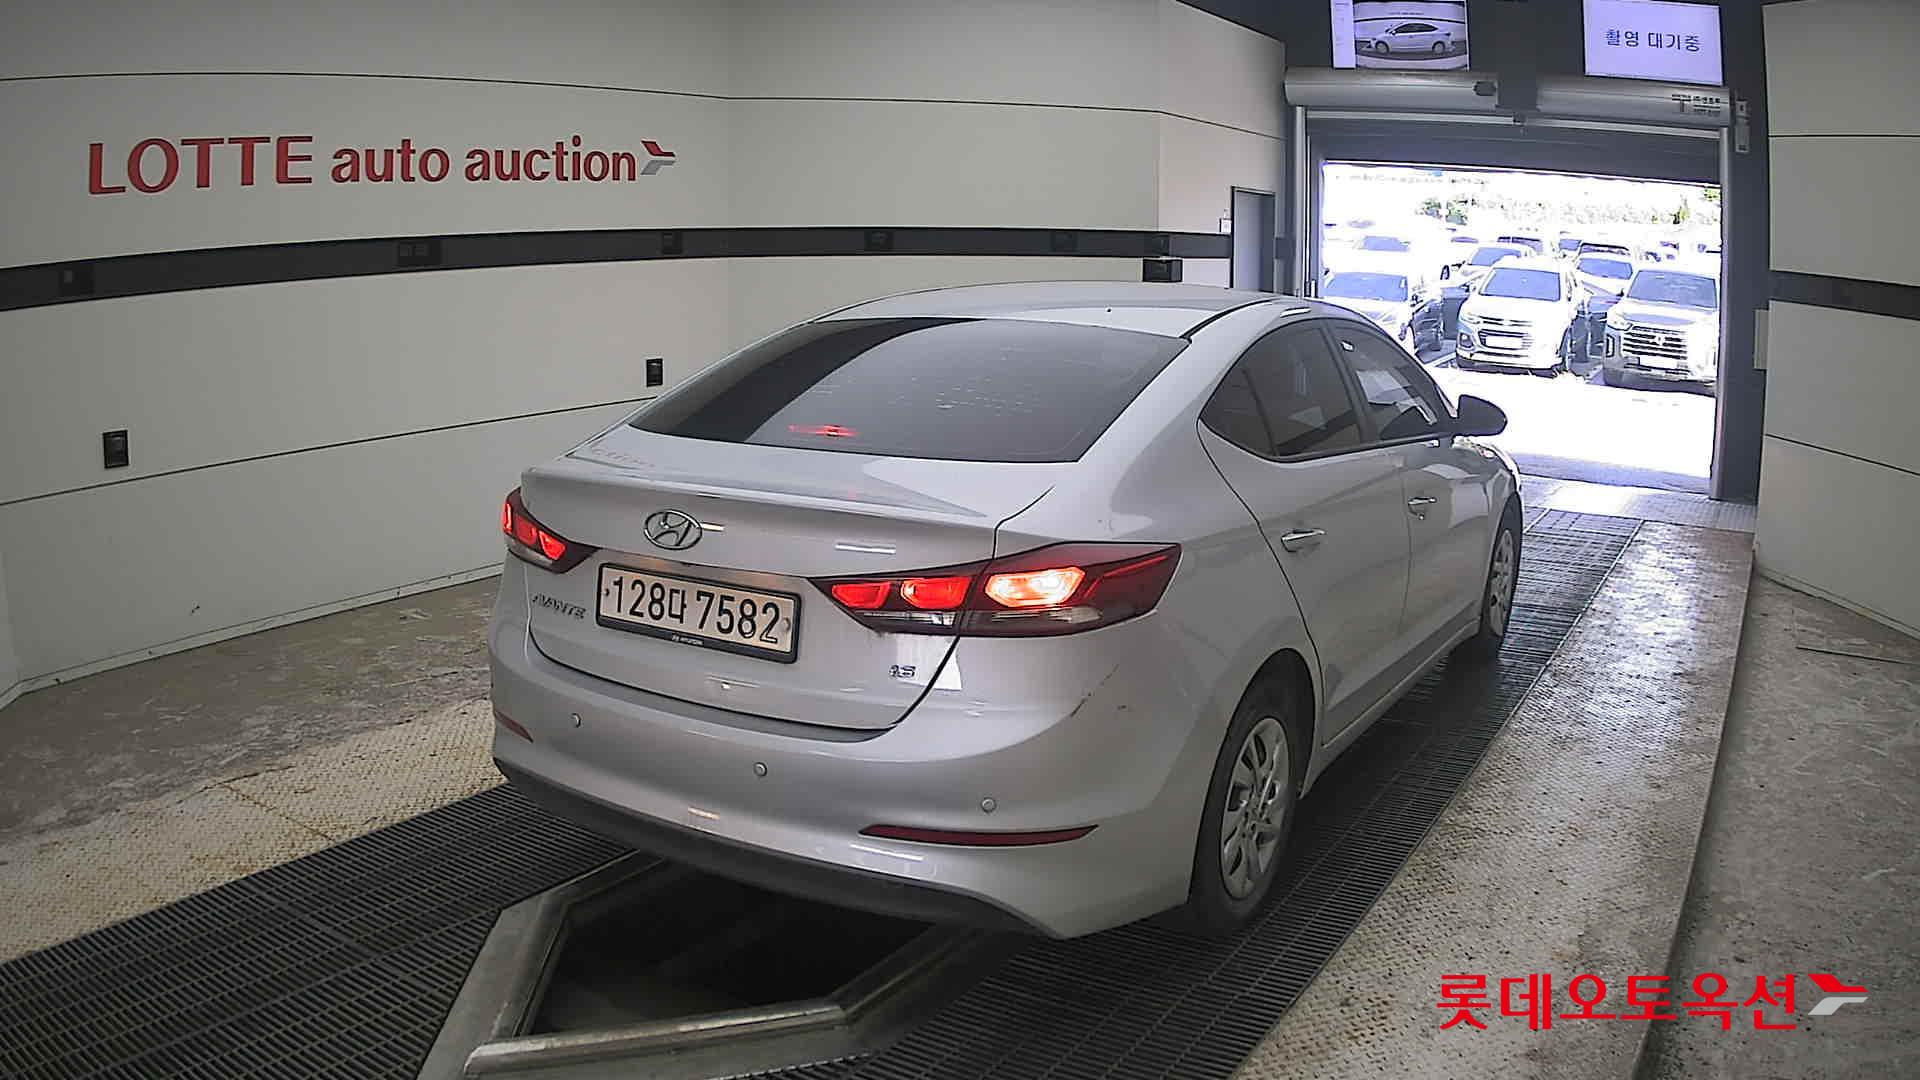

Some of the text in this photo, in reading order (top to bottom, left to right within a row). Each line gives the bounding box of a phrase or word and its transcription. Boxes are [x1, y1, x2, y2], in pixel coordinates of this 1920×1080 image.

[1648, 32, 1700, 52] 대기중
[90, 135, 638, 195] LOTTE auto auction
[613, 576, 780, 644] 128다 7582
